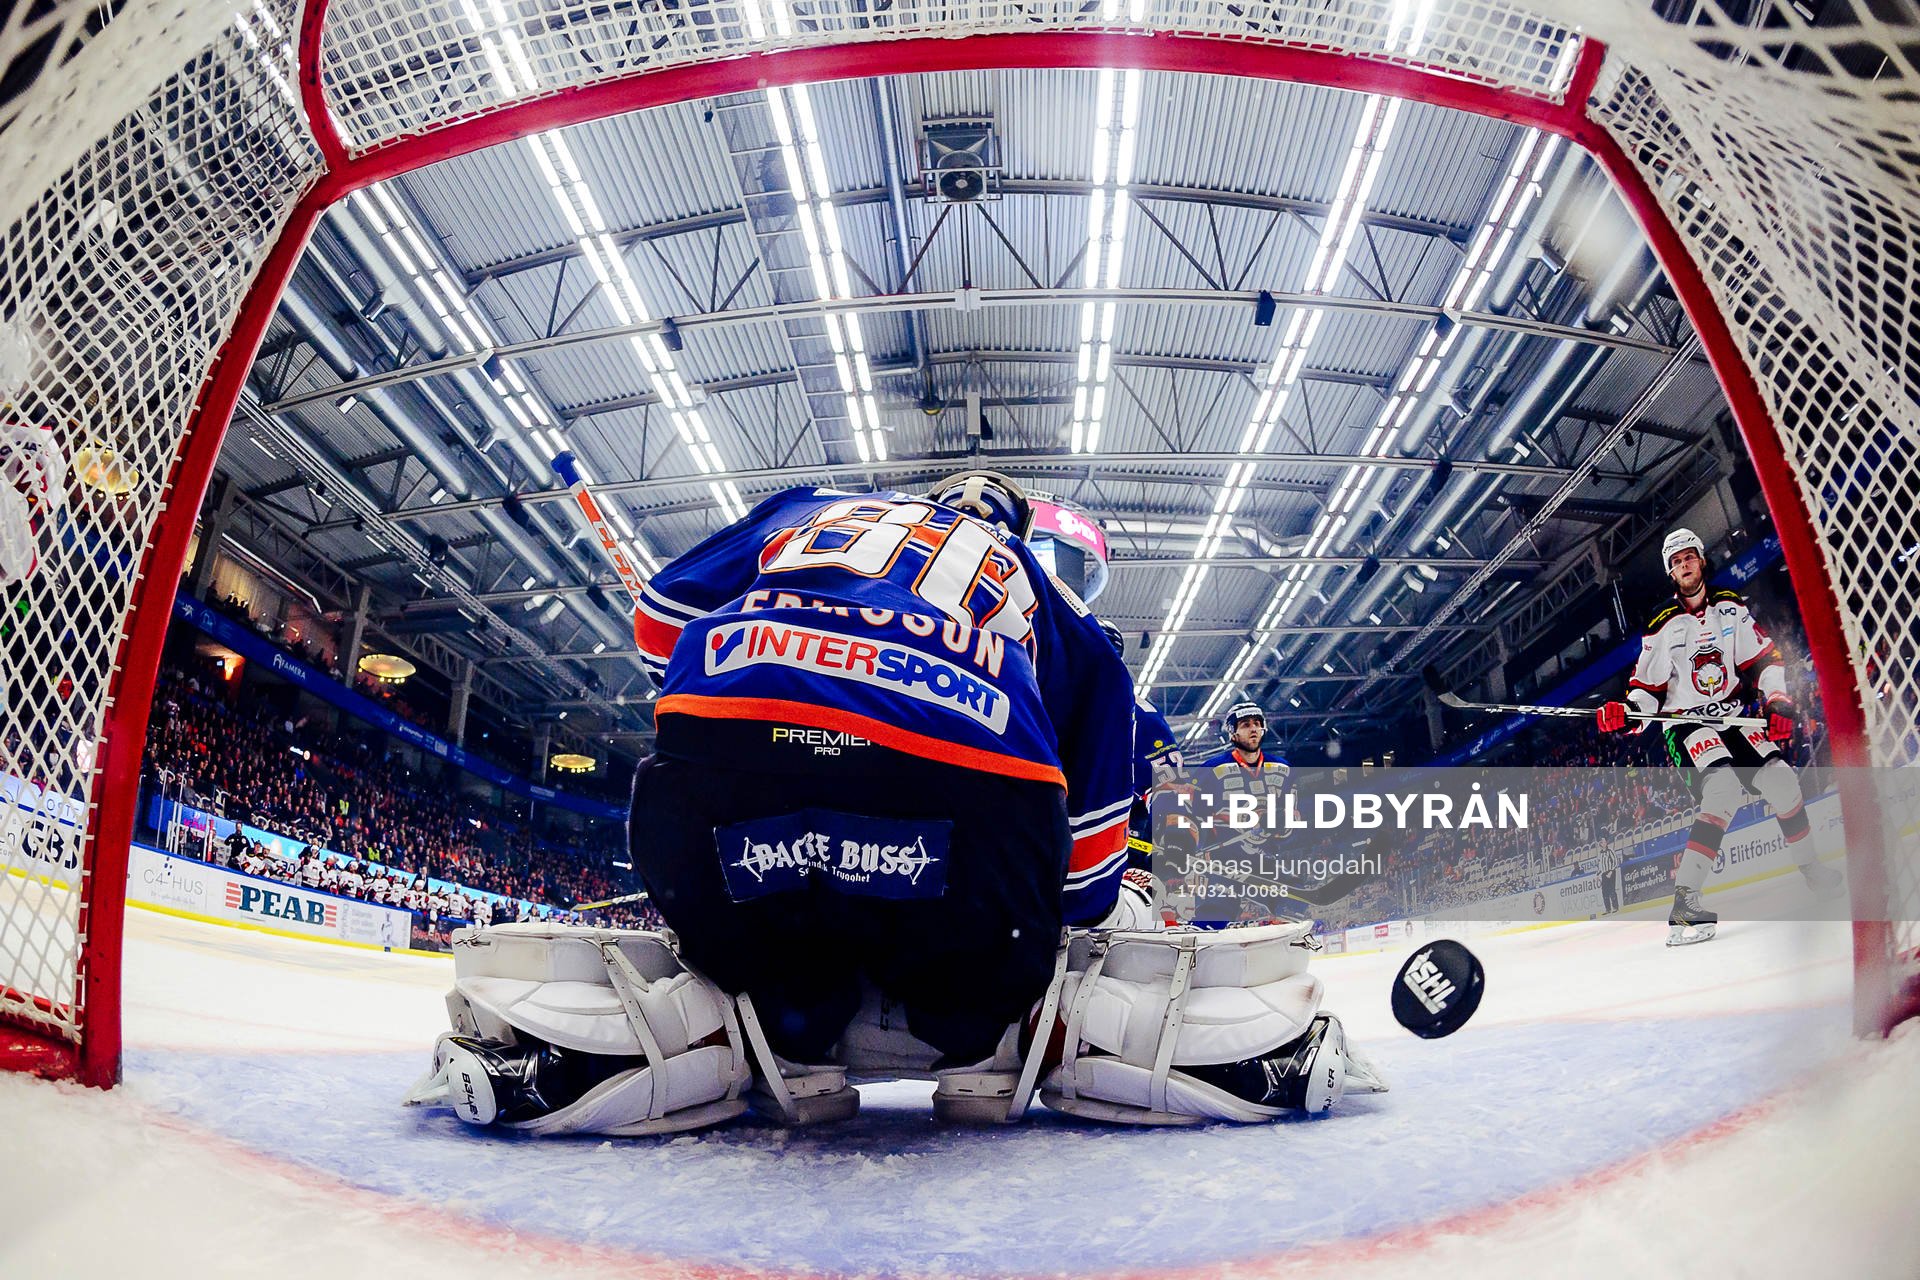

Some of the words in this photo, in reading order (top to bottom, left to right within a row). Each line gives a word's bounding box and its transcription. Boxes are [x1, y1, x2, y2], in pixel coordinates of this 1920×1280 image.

[747, 626, 999, 718] INTERSPORT
[772, 727, 884, 746] PREMIE
[814, 747, 841, 756] PRO
[1151, 751, 1190, 784] 52
[839, 840, 917, 875] BUSS
[1730, 834, 1789, 864] Elitfönste
[172, 876, 203, 895] HUS
[239, 884, 325, 926] PEAB
[1409, 959, 1456, 1010] SHL
[461, 1071, 481, 1121] BAUE
